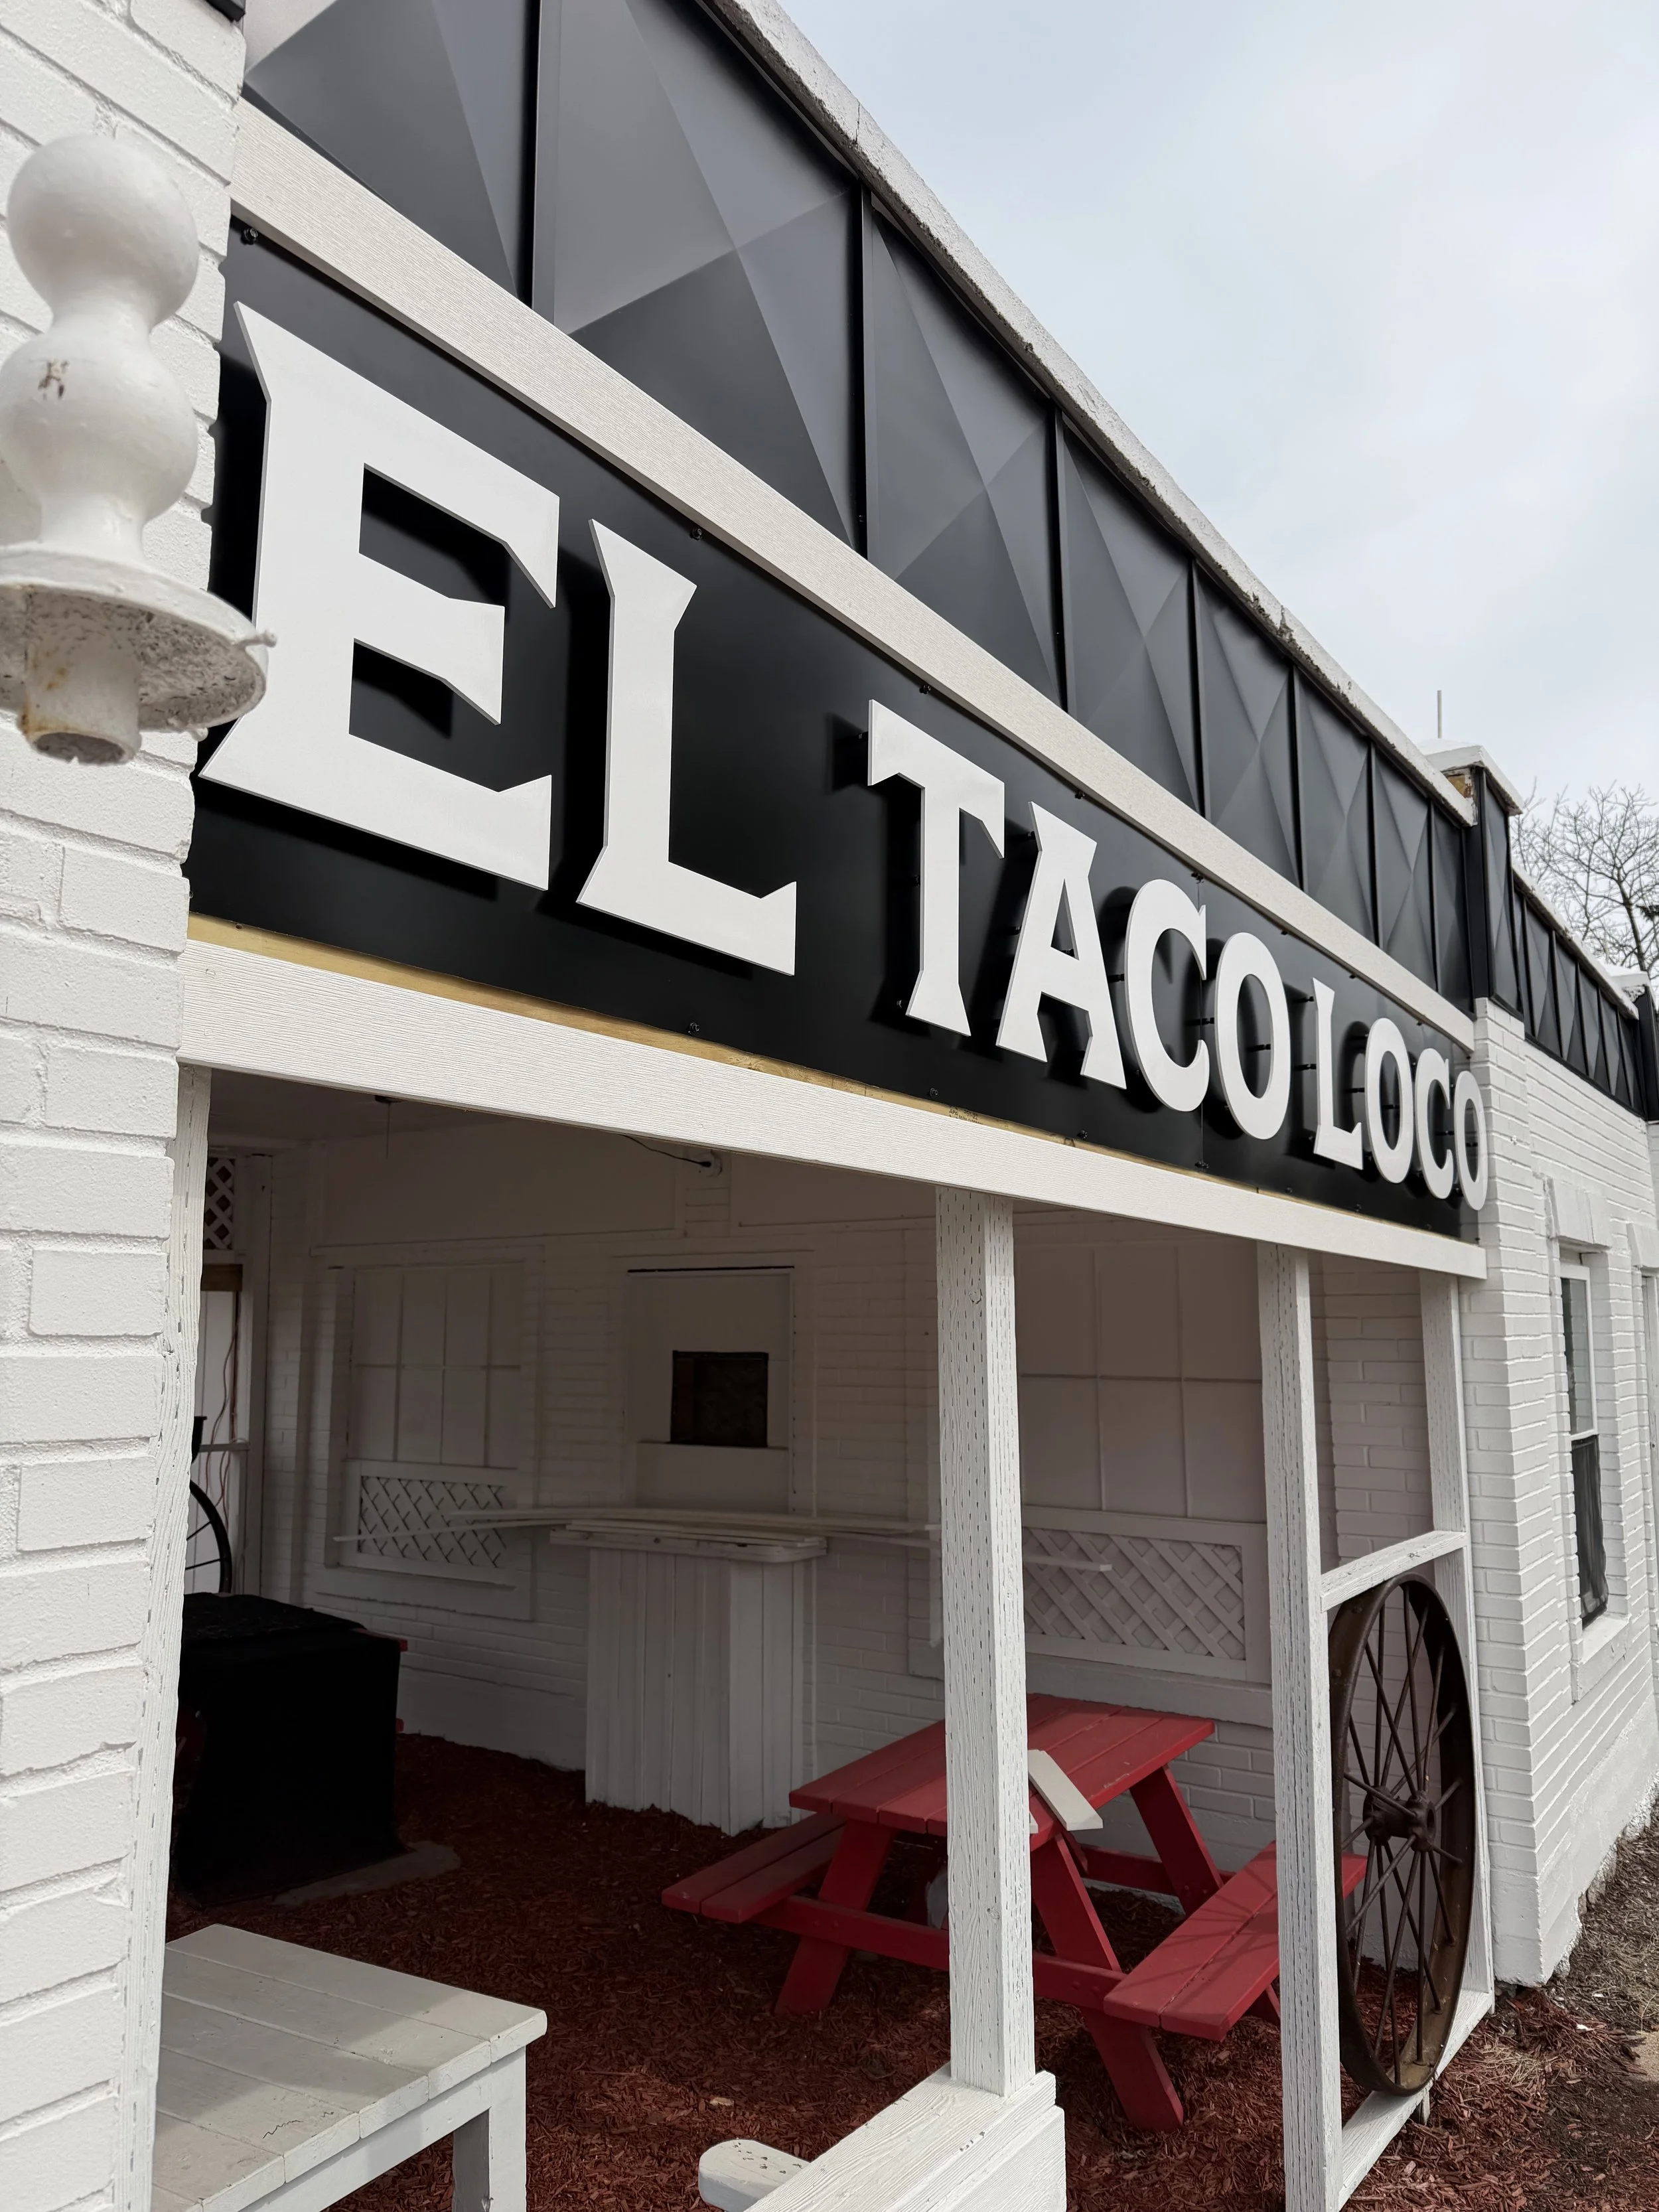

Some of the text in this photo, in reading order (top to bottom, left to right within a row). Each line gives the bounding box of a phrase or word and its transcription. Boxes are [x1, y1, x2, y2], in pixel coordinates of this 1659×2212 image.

[198, 301, 1488, 1211] EL TACO LOCO
